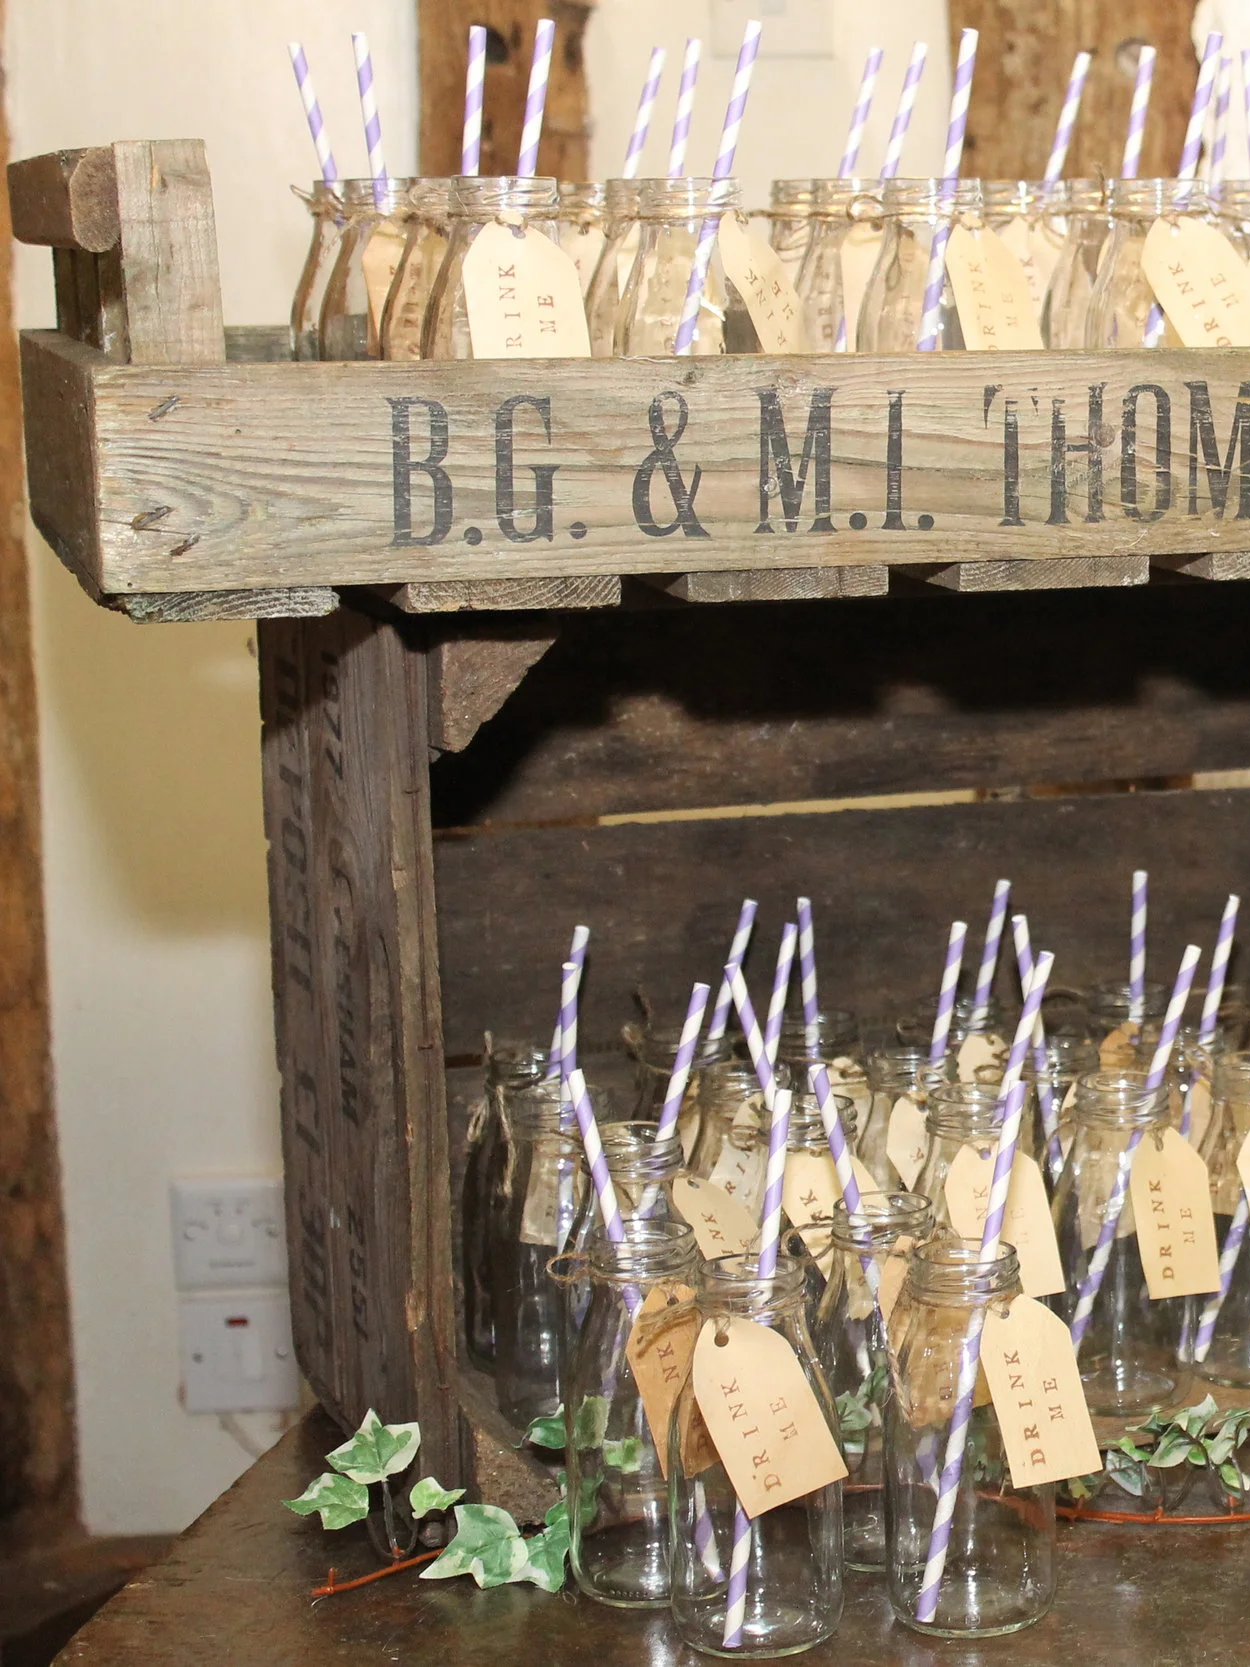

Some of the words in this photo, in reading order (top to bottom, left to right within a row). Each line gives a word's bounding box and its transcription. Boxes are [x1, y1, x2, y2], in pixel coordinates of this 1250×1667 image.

[497, 263, 523, 349] RINK
[537, 294, 557, 334] ME
[386, 395, 588, 548] B.G.
[632, 390, 713, 538] &
[753, 385, 935, 534] M.I.
[1148, 1179, 1175, 1281] DRINK
[1179, 1207, 1196, 1244] ME
[720, 1377, 783, 1492] DRINK
[769, 1397, 799, 1441] ME
[1003, 1350, 1047, 1466] DRINK
[1043, 1377, 1065, 1422] ME
